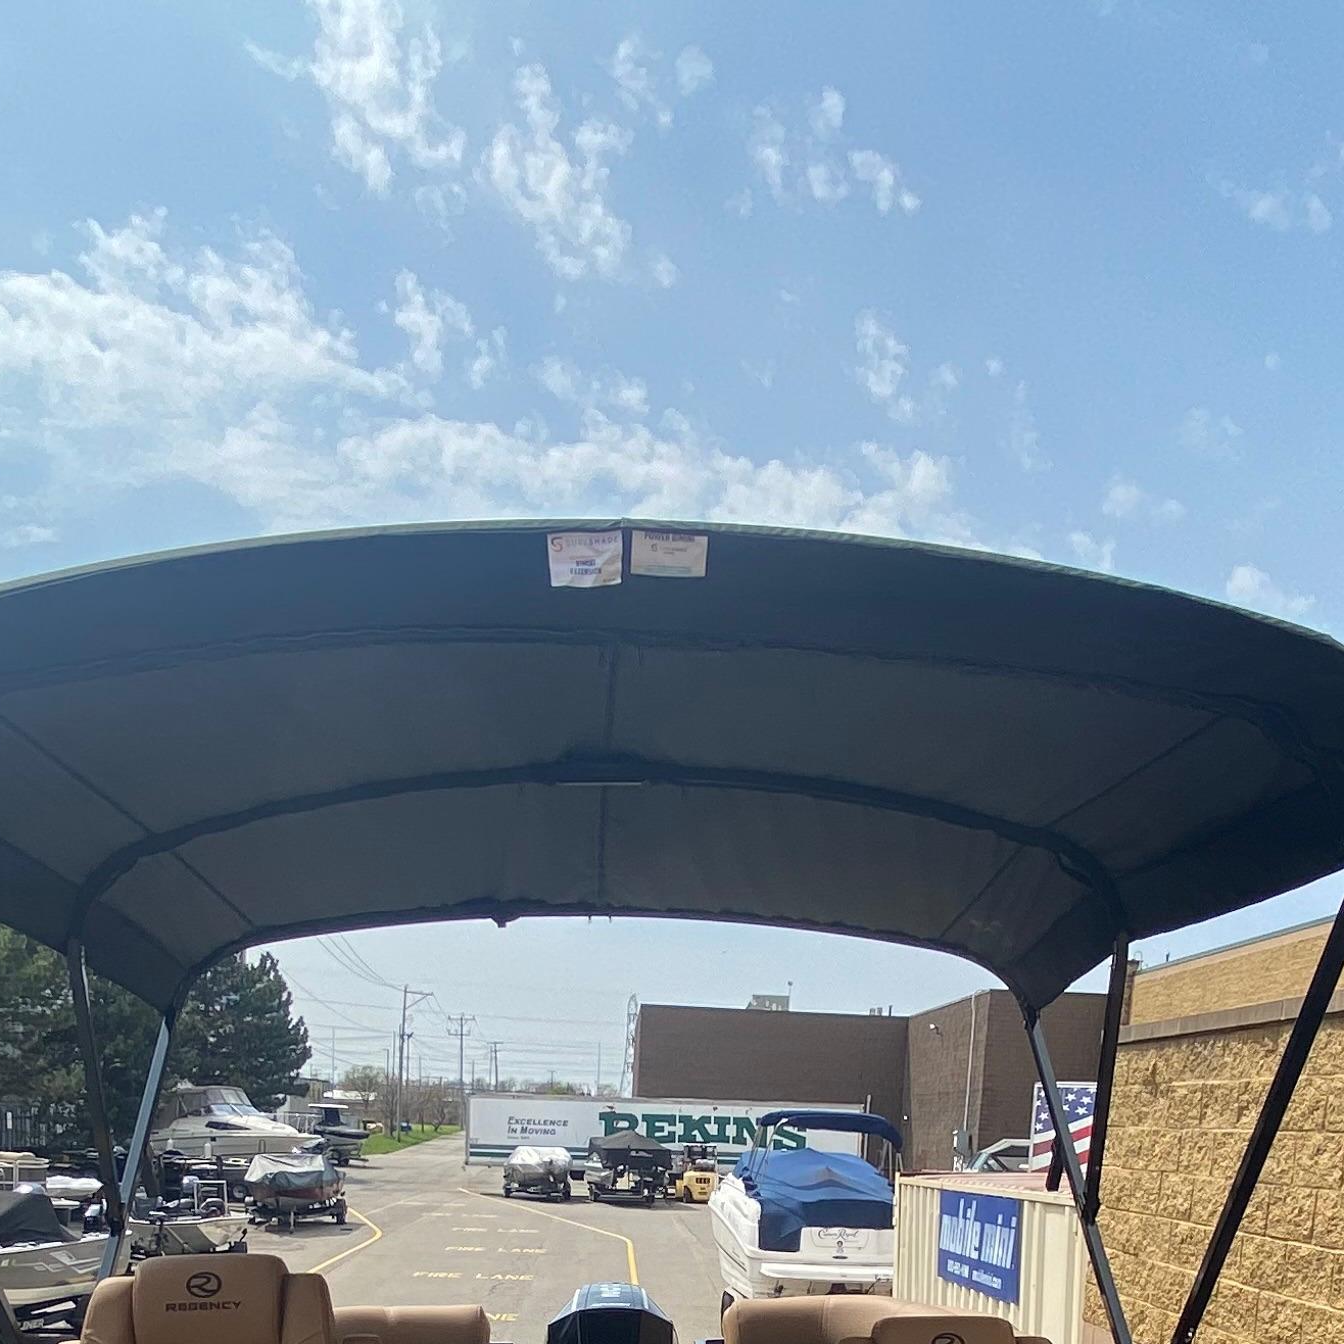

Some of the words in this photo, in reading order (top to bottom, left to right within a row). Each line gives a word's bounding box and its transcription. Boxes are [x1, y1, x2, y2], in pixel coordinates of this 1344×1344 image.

[507, 1116, 569, 1127] EXCELLENCE
[939, 1197, 981, 1260] mobile
[980, 1213, 1017, 1270] mini
[412, 1271, 464, 1279] FIRE
[475, 1272, 536, 1281] LANE
[165, 1301, 242, 1312] REGENCY
[485, 1312, 520, 1322] NE
